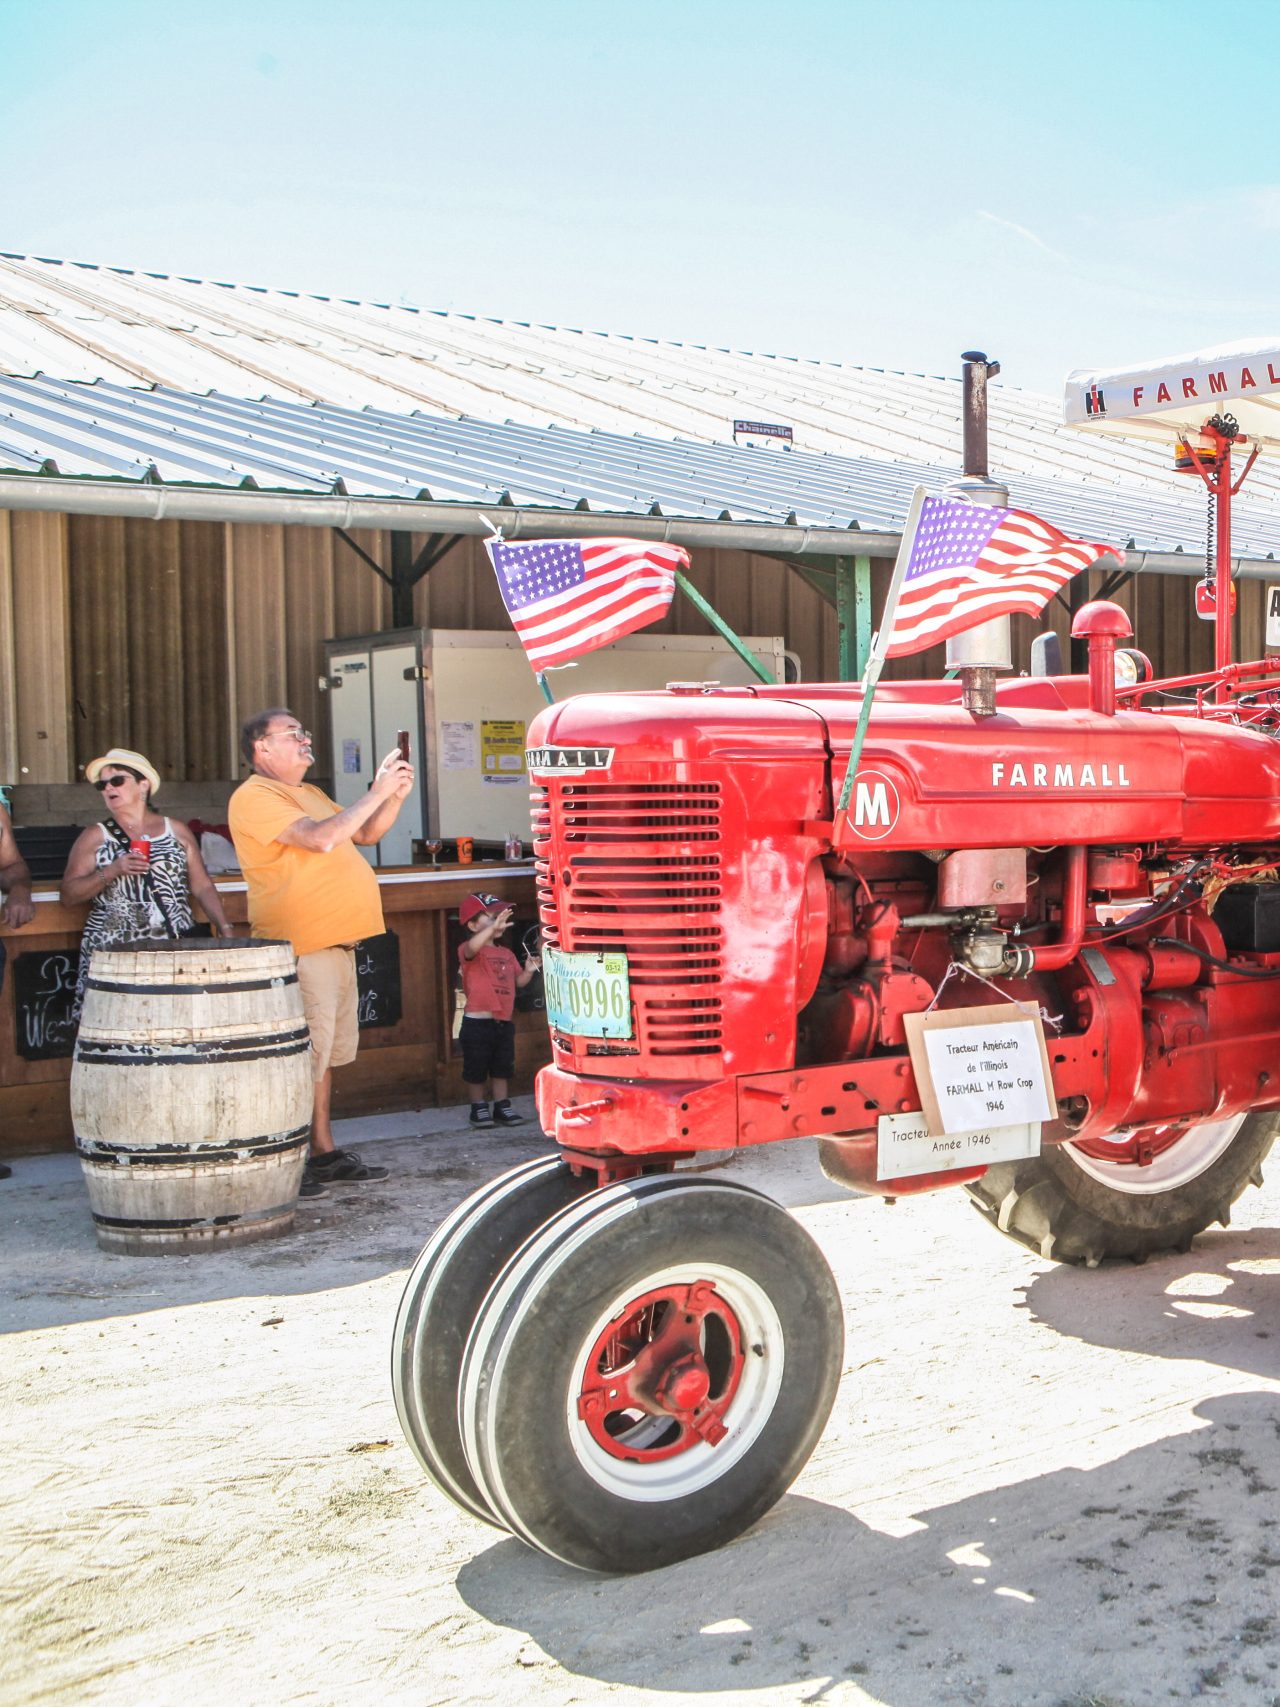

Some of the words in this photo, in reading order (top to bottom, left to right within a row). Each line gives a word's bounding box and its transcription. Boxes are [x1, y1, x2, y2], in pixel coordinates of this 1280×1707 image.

[992, 763, 1131, 787] FARMALL
[855, 782, 890, 826] M
[568, 978, 623, 1019] 0996
[946, 1043, 979, 1055] Tracteur
[982, 1040, 1018, 1051] Américain
[967, 1063, 976, 1073] de
[946, 1082, 984, 1096] FARMALL
[987, 1081, 994, 1091] M
[998, 1080, 1013, 1090] Row
[1018, 1077, 1033, 1089] Crop
[986, 1101, 1004, 1112] 1946
[892, 1129, 929, 1143] Tracteu
[932, 1139, 962, 1152] Année
[967, 1133, 991, 1147] 1946
